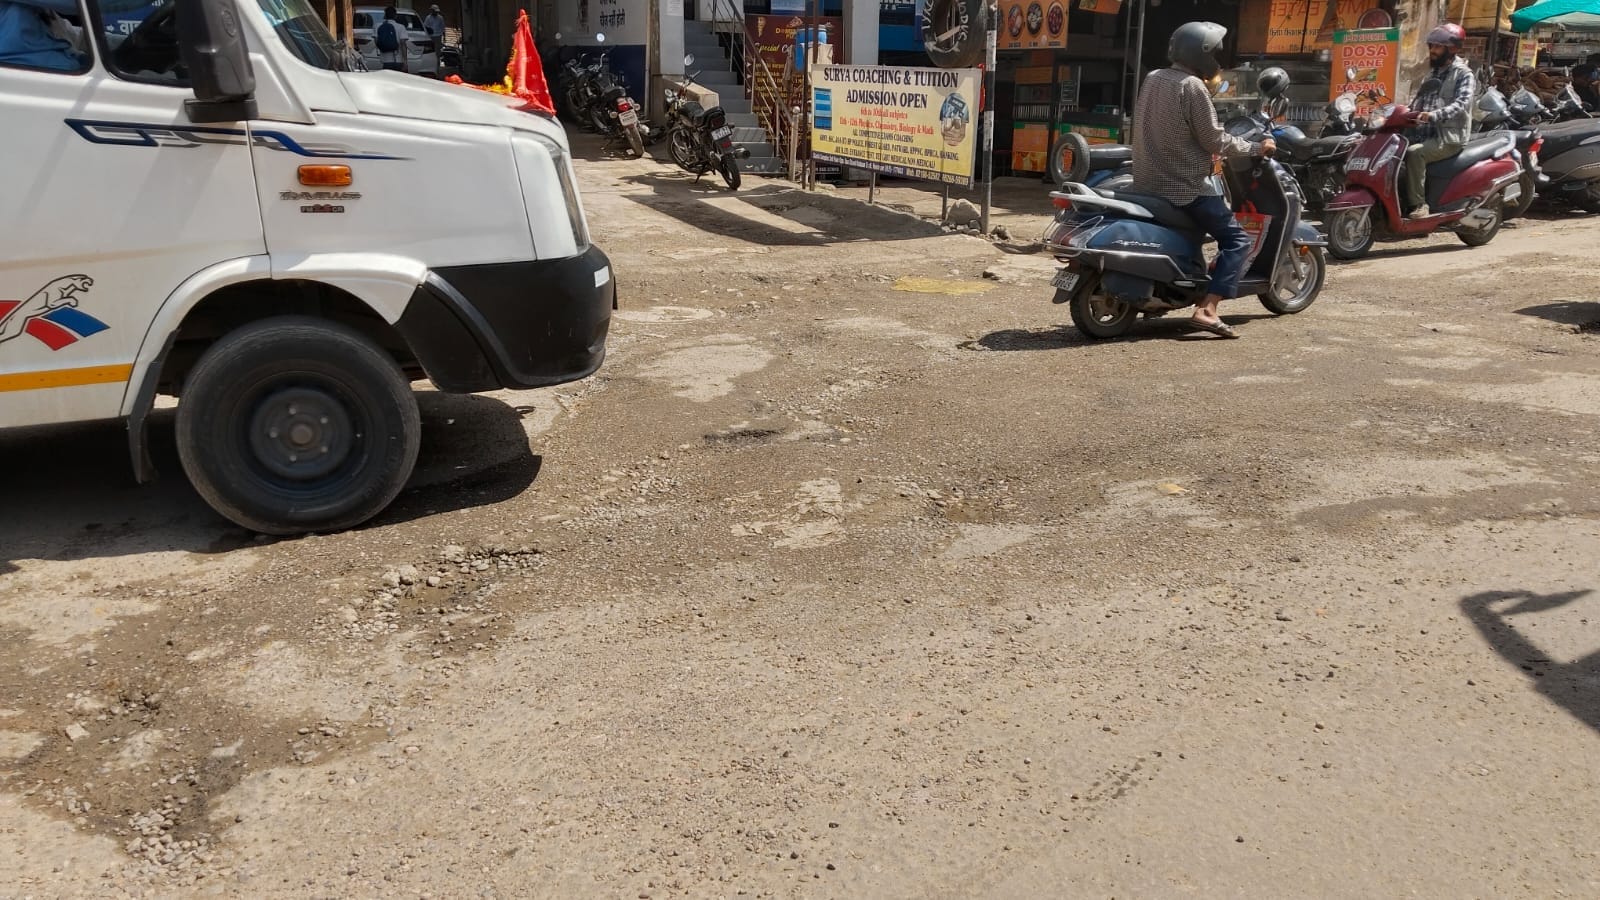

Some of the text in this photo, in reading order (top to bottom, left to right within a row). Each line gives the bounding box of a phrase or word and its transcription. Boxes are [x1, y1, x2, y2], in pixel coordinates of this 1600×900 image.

[1343, 45, 1388, 58] DOSA
[1343, 58, 1384, 68] PLANE
[824, 67, 959, 88] SURYA COACHING & TUITION
[846, 88, 928, 109] ADMISSION OPEN
